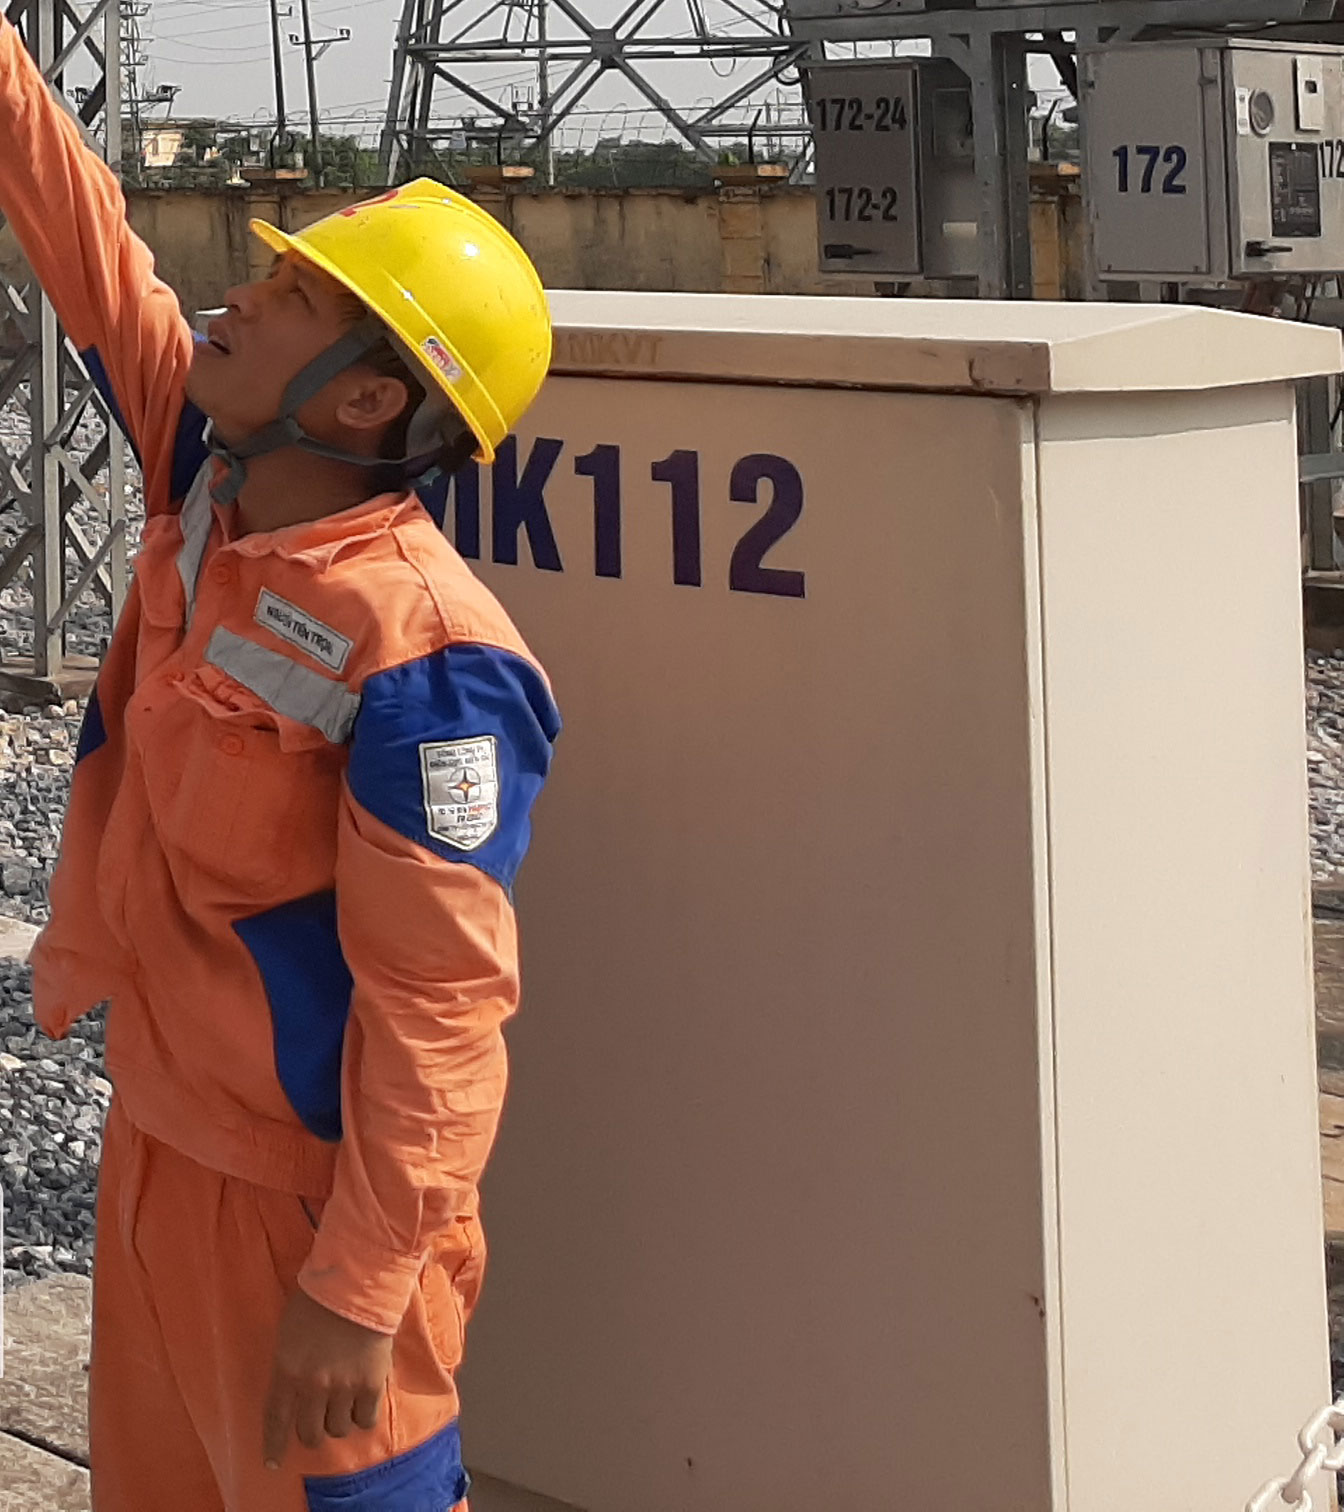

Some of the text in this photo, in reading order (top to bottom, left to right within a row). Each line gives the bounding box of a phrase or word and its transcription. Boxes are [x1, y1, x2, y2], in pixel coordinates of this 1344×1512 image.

[816, 97, 907, 131] 172-24
[1113, 145, 1187, 194] 172
[826, 187, 898, 221] 172-2
